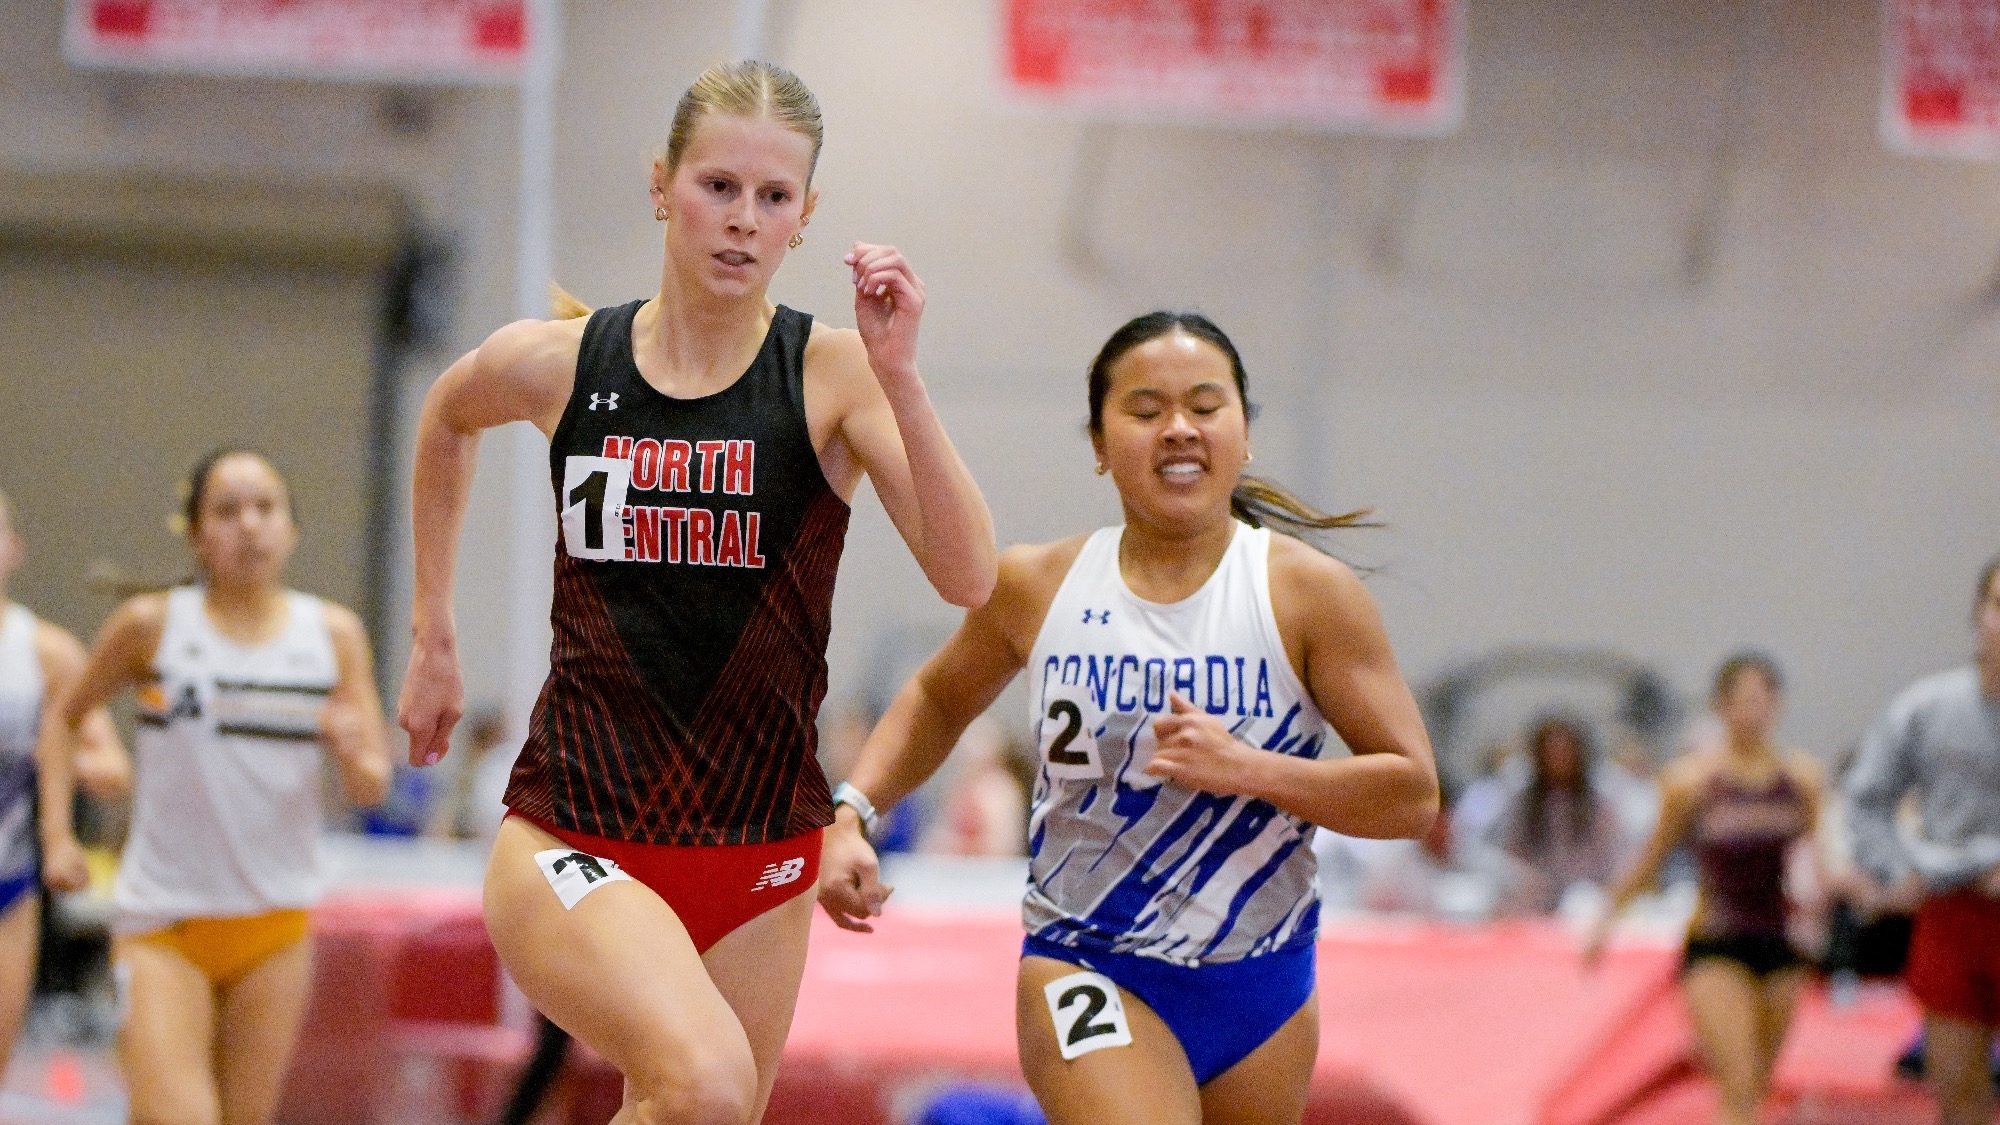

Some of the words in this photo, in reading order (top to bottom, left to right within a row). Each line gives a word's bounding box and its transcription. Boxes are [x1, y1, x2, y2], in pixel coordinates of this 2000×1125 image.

[569, 470, 609, 549] 1
[1047, 699, 1091, 765] 2
[1057, 984, 1118, 1047] 2
